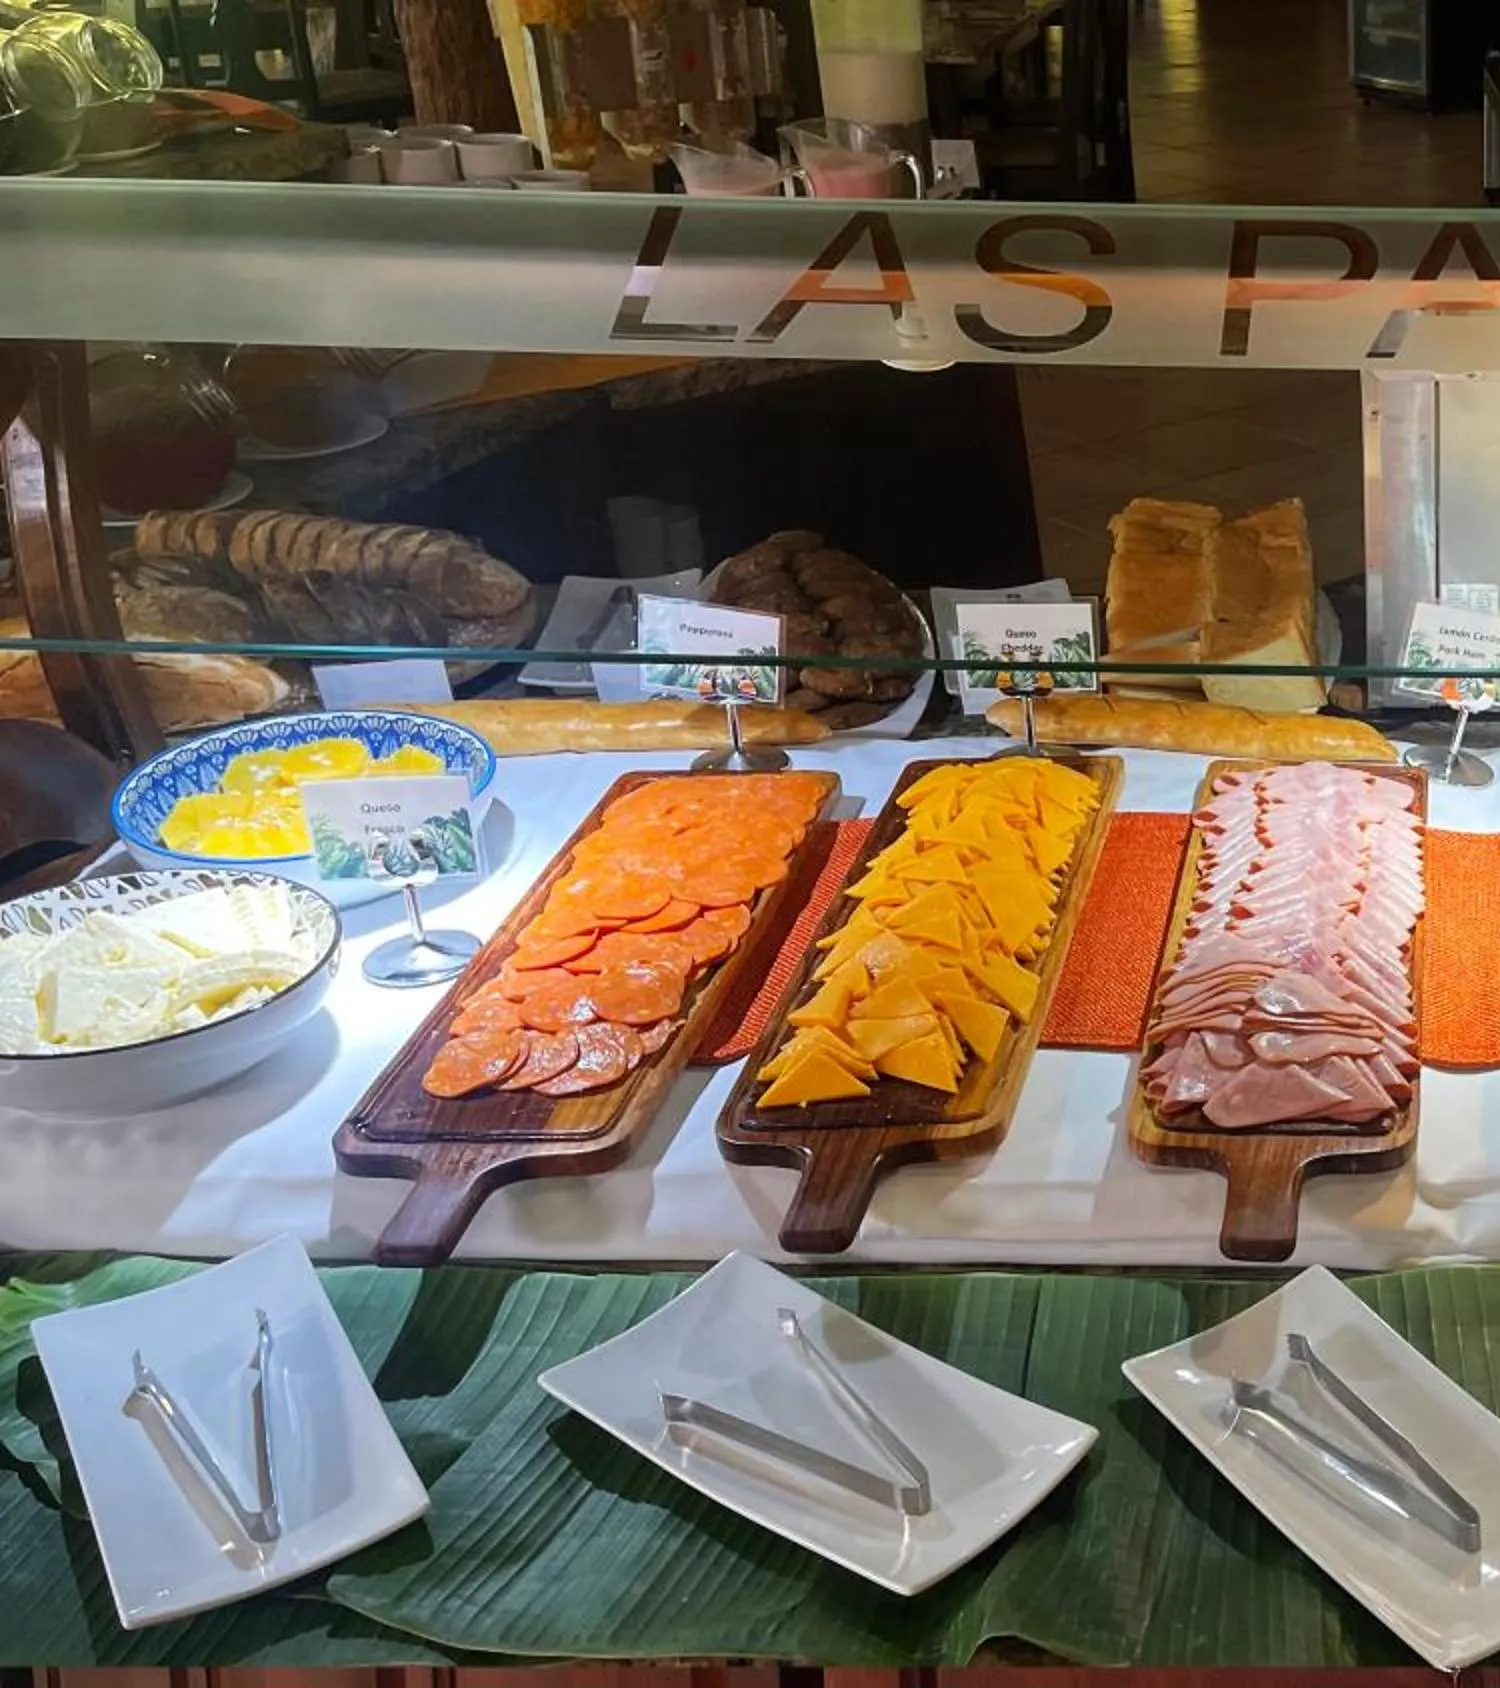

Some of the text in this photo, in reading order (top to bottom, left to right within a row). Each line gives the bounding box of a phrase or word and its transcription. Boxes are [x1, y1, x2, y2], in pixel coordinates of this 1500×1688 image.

[609, 205, 1116, 354] LAS
[1005, 628, 1037, 639] Queso
[361, 803, 401, 814] Queso
